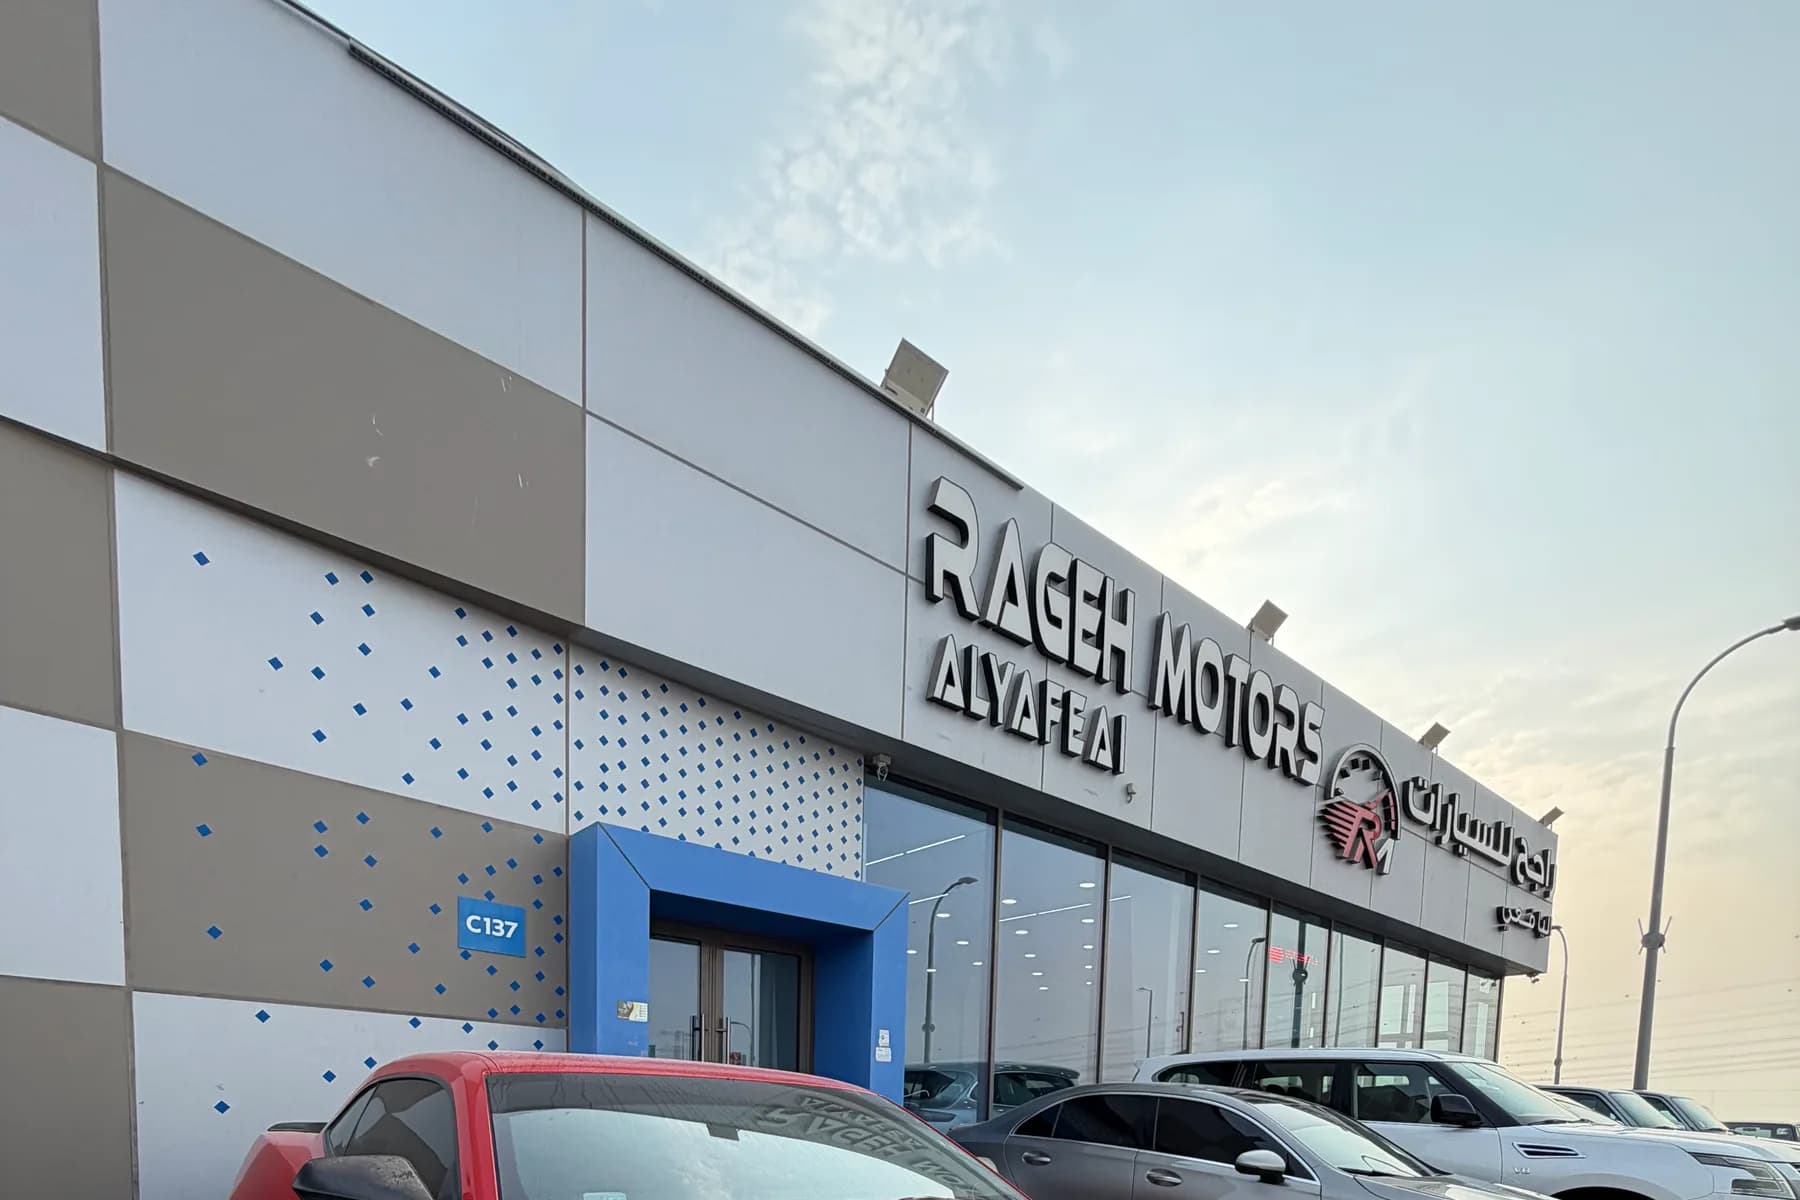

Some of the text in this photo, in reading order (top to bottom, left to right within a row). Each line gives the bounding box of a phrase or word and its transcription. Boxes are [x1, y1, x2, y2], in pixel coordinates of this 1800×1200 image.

[926, 476, 1326, 787] RAGEH MOTORS
[927, 634, 1127, 775] ALYAFEAI
[1402, 776, 1514, 867] للسيارات
[466, 914, 518, 938] C137
